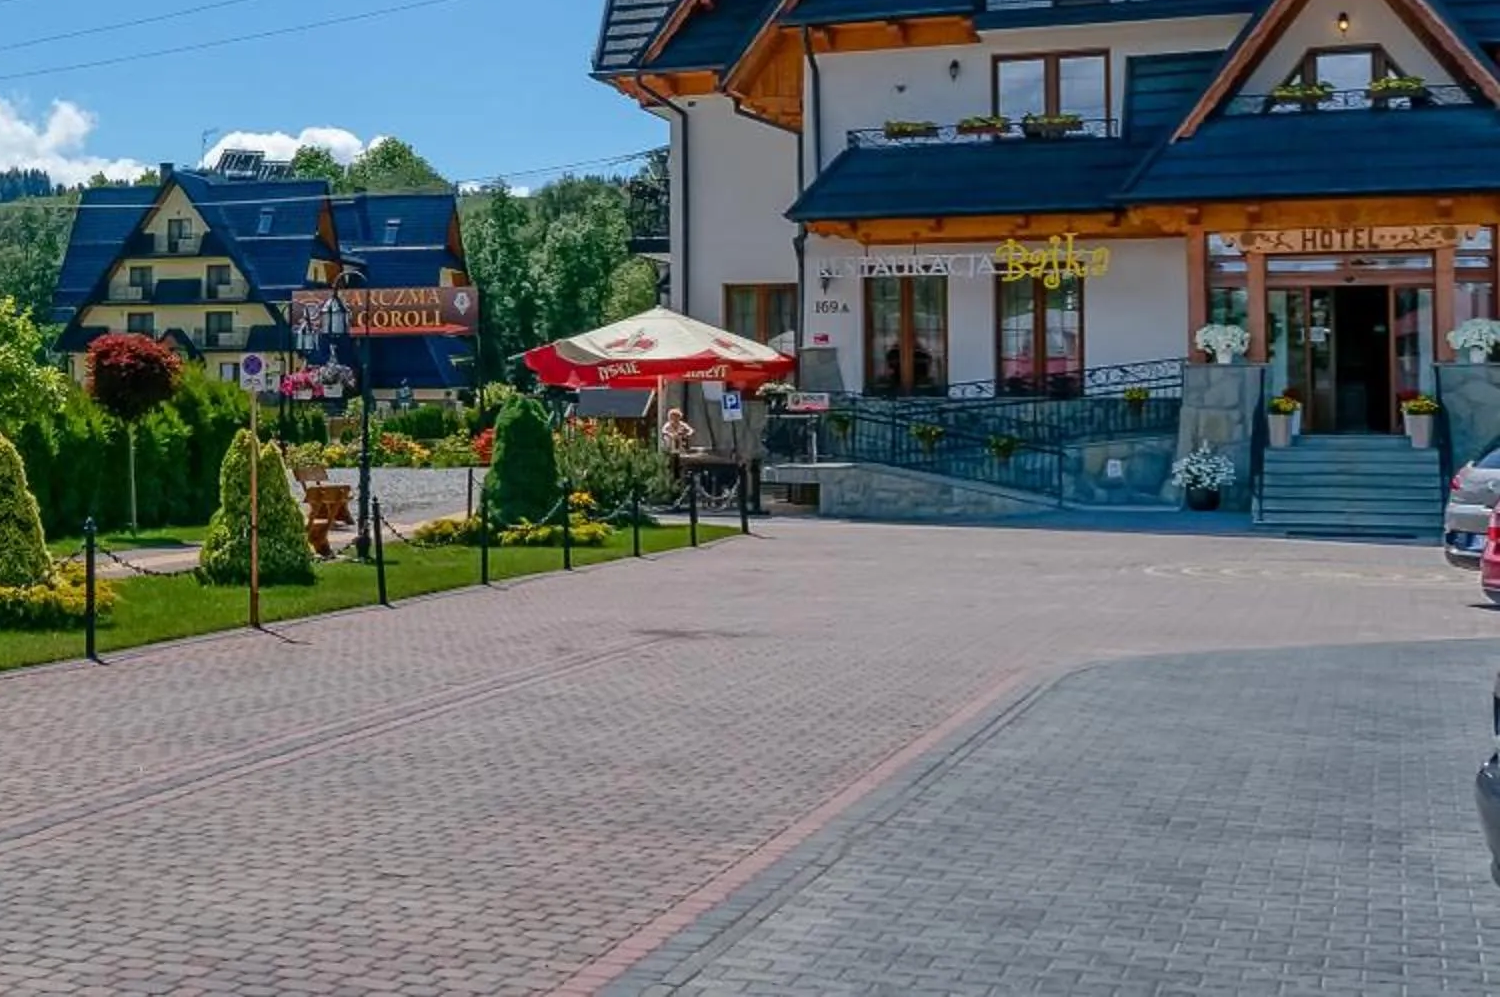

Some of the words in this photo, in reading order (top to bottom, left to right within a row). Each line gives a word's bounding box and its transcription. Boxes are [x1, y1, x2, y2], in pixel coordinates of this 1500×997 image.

[1301, 228, 1380, 252] HOTEL
[816, 253, 997, 278] RESTAURACJA
[995, 232, 1111, 290] Bajka
